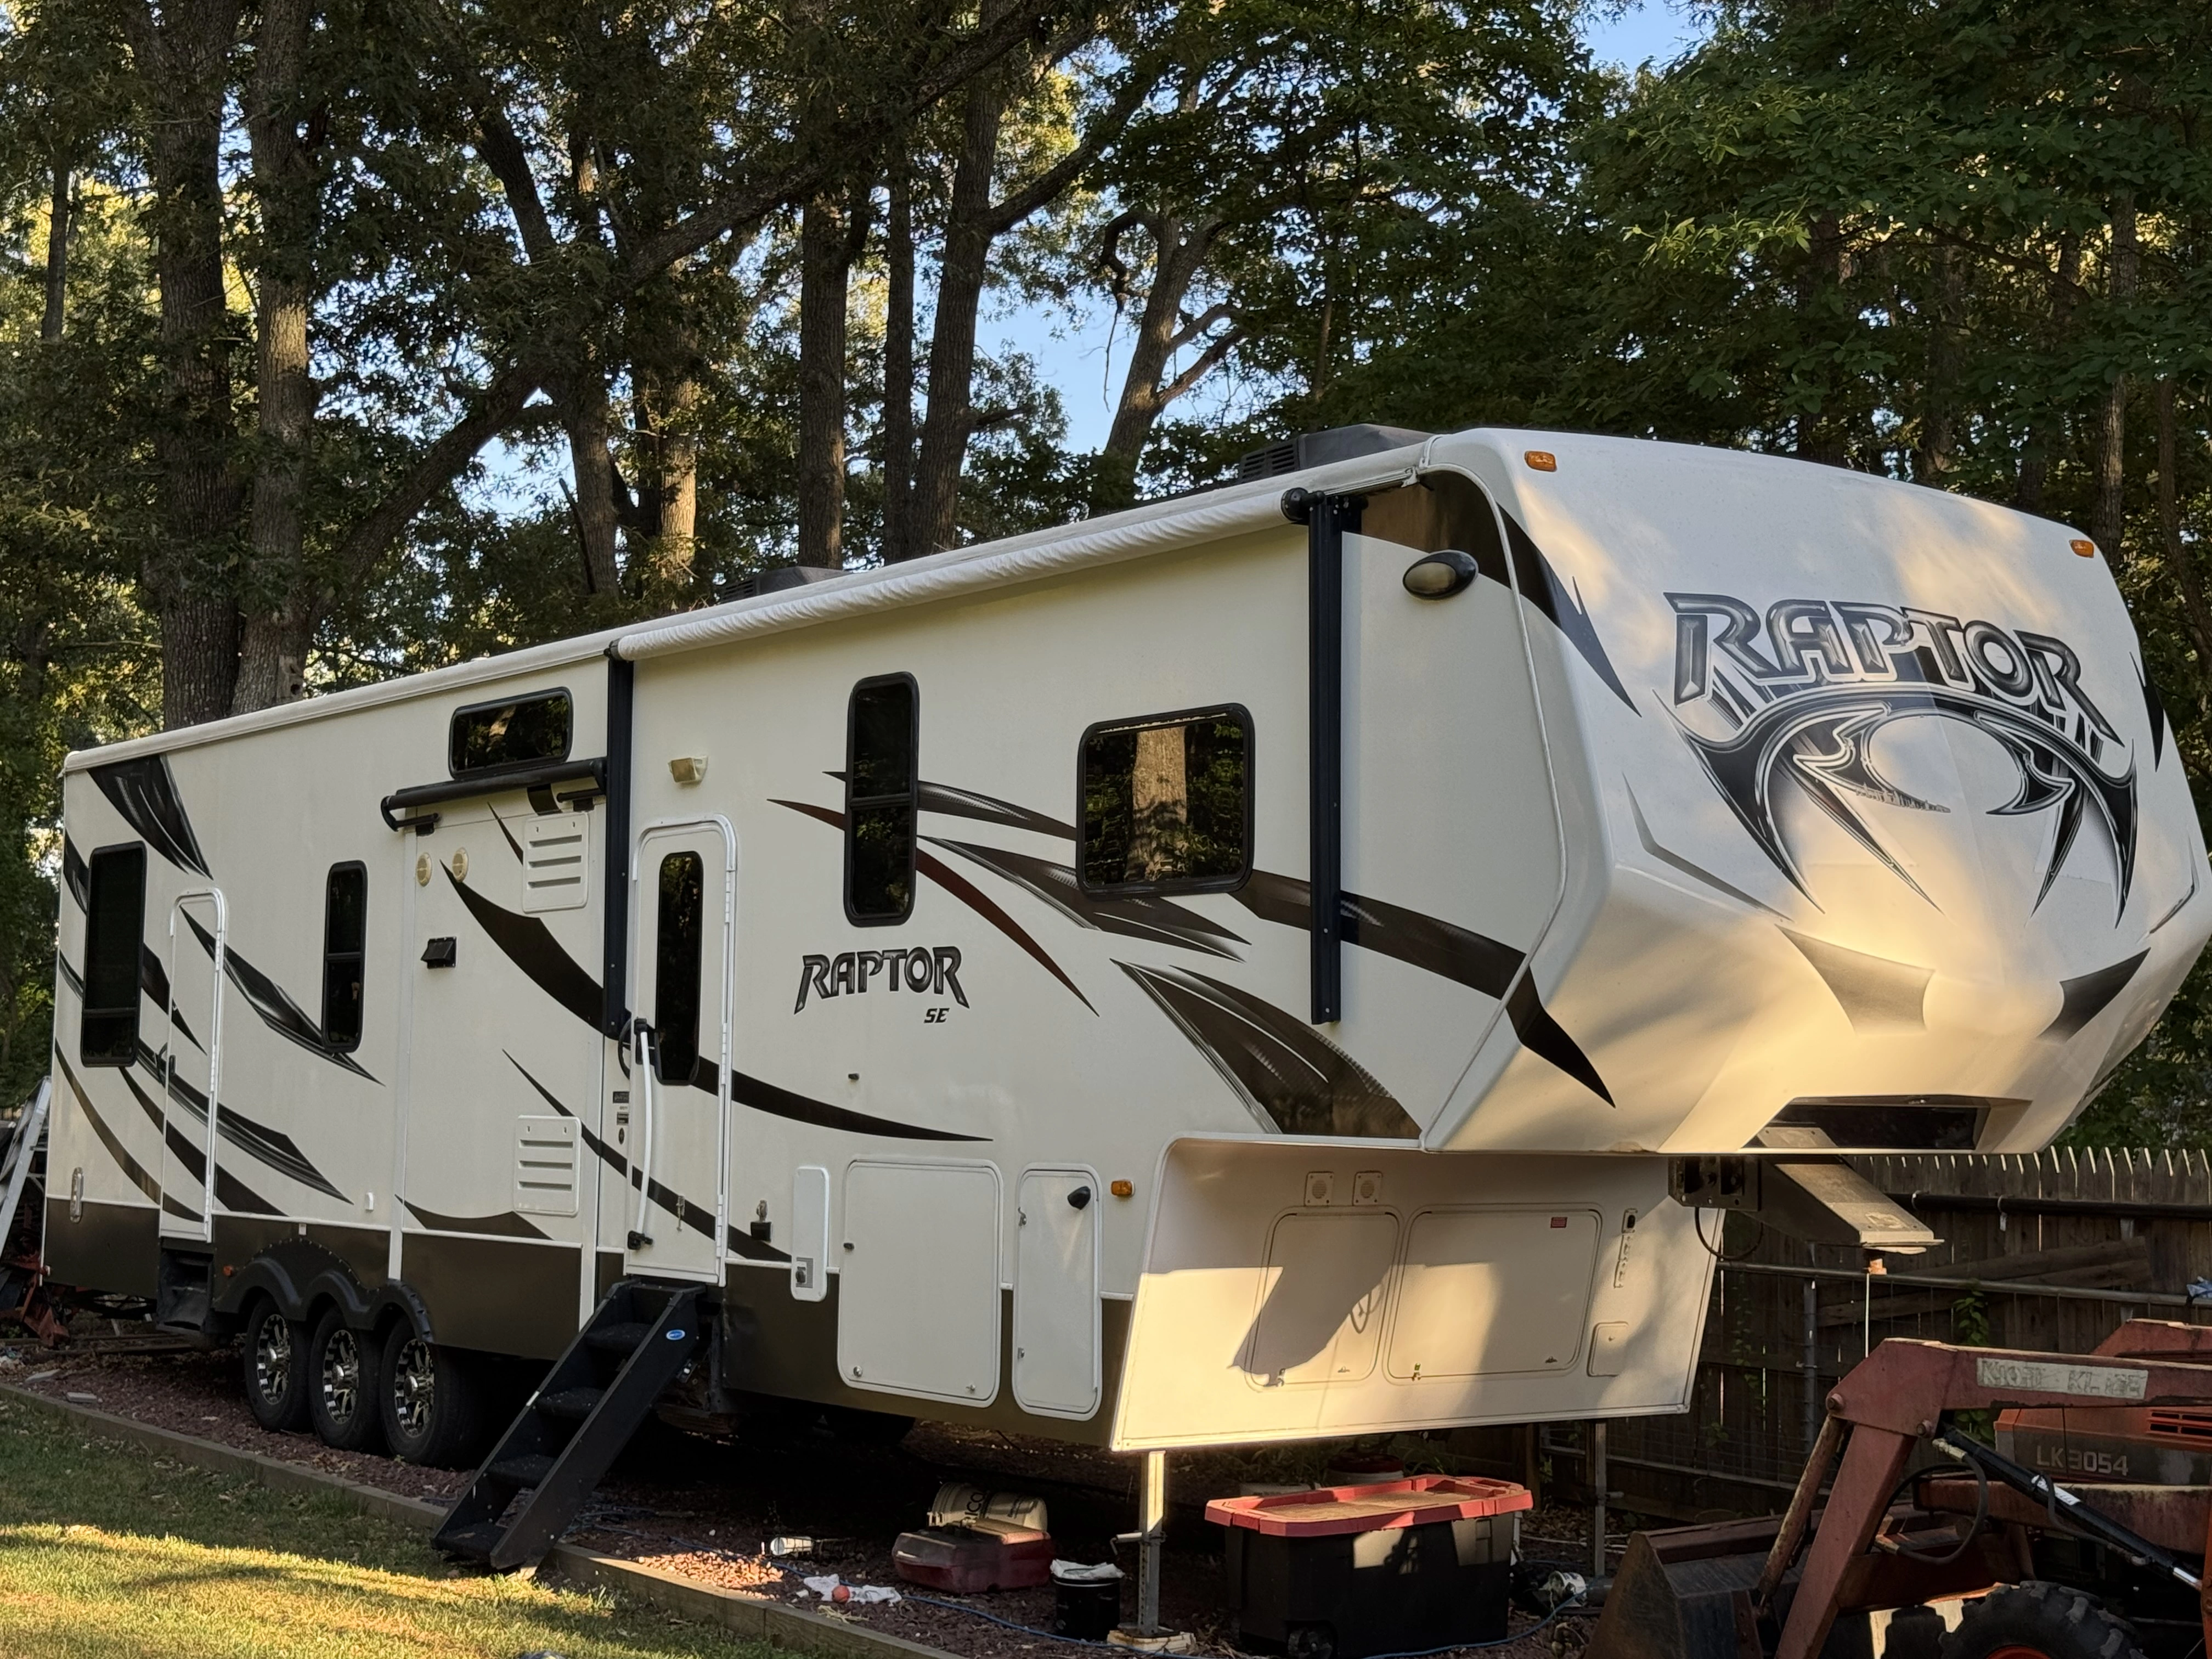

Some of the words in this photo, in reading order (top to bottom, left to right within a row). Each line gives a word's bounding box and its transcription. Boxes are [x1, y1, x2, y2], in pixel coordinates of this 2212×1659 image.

[1663, 592, 2126, 748] RAPTOR
[794, 946, 969, 1015] RAPTOR
[924, 1008, 950, 1023] SE
[2067, 1370, 2100, 1394] KL
[2036, 1445, 2129, 1476] LK3054
